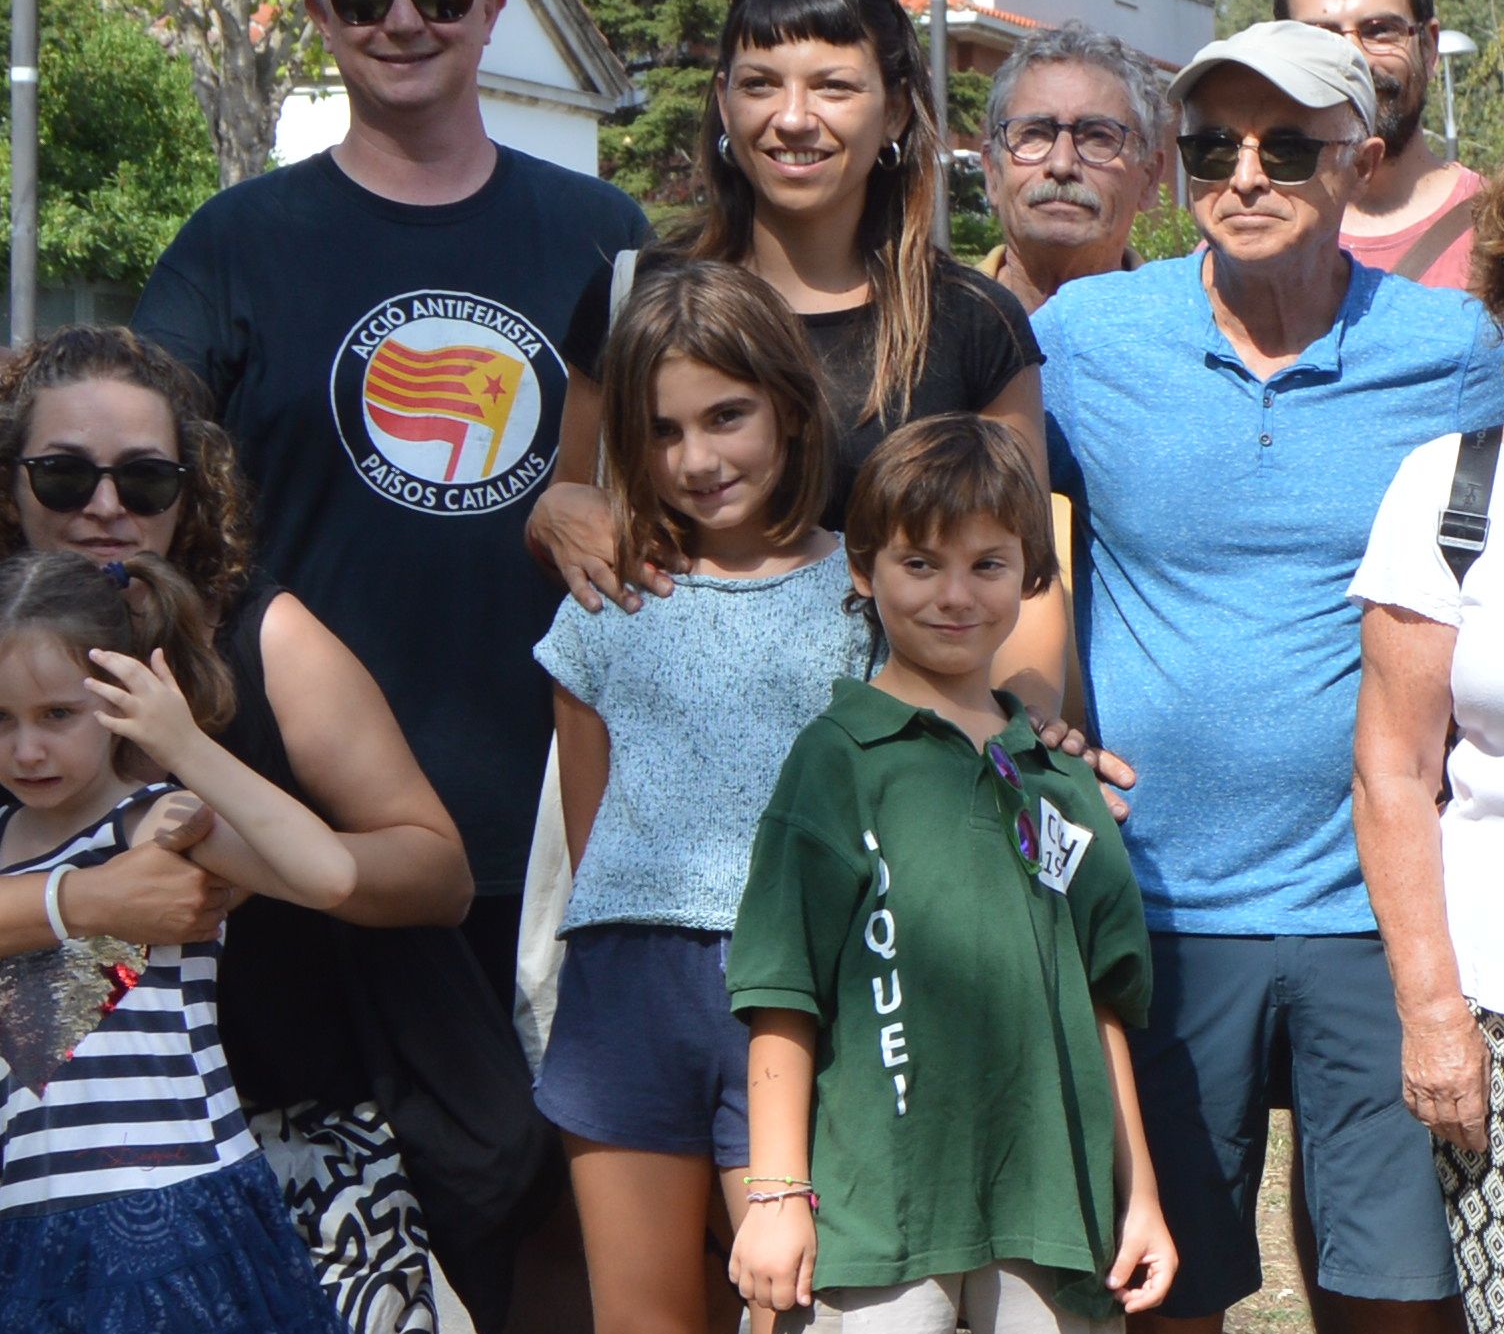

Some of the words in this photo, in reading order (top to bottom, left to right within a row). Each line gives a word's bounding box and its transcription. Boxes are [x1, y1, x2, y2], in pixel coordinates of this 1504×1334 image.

[350, 301, 407, 360] ACCIÓ
[412, 297, 544, 360] ANTIFEIXISTA
[360, 453, 437, 508] PAÏSOS
[444, 452, 546, 511] CATALANS
